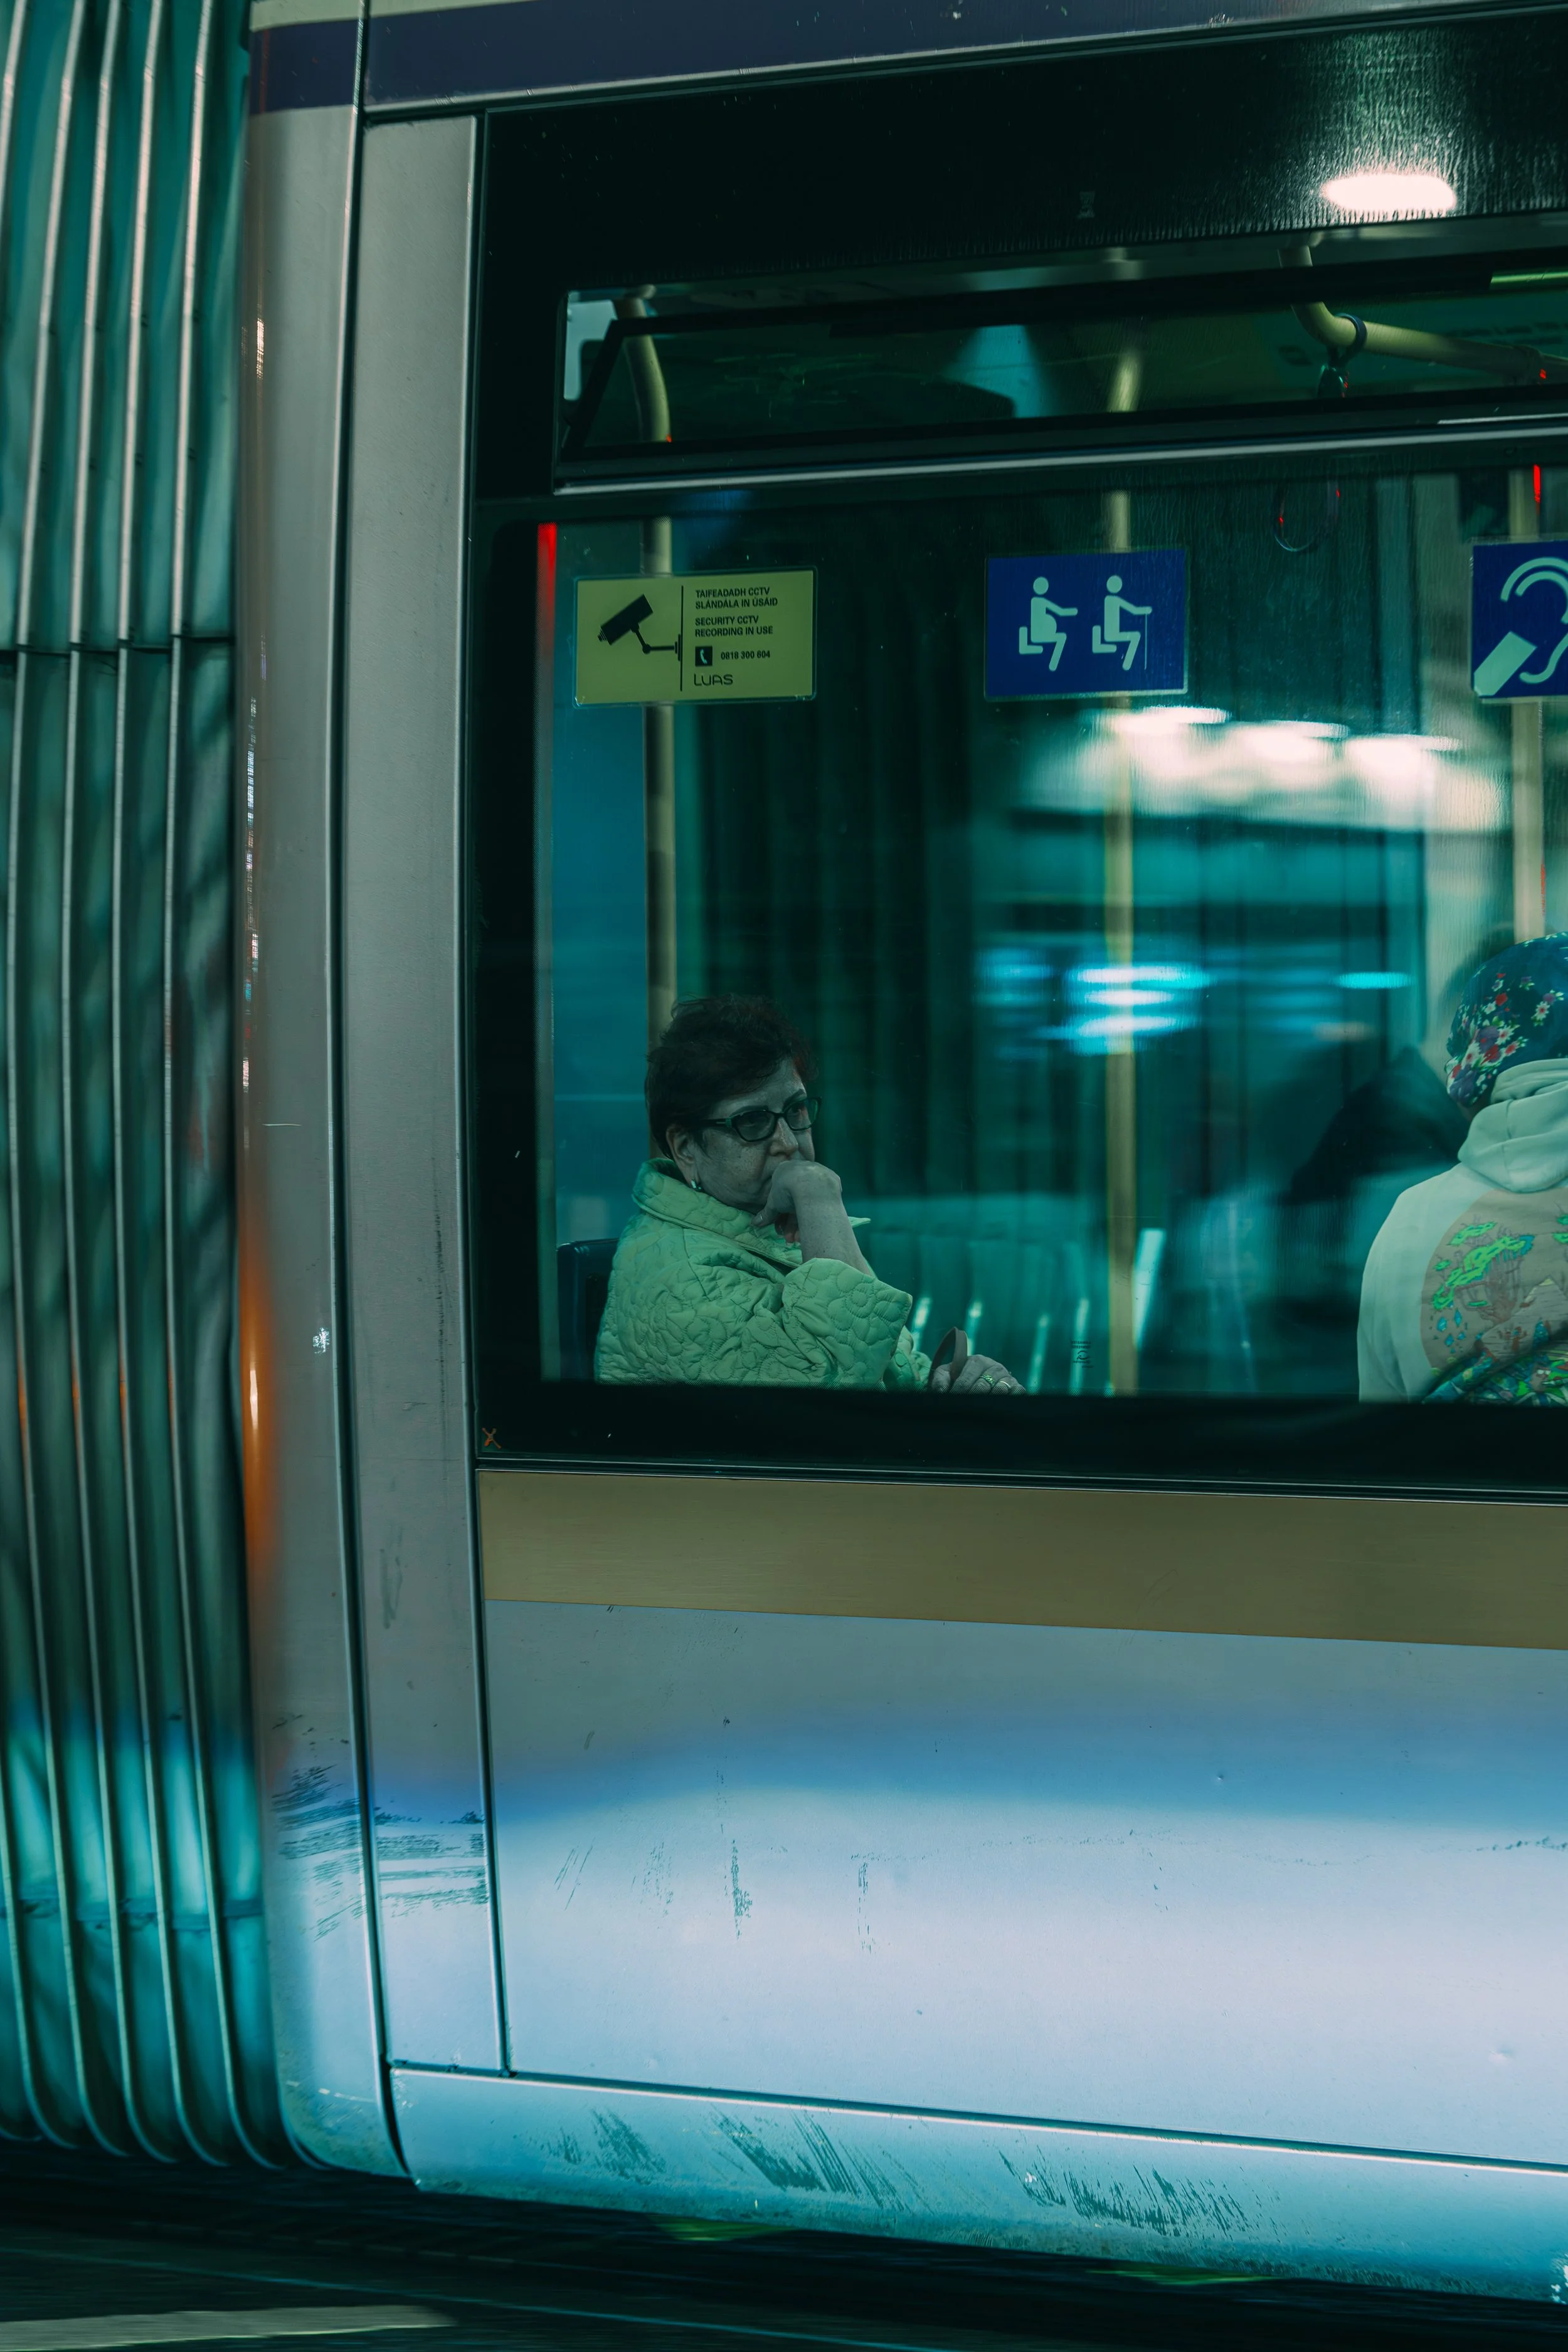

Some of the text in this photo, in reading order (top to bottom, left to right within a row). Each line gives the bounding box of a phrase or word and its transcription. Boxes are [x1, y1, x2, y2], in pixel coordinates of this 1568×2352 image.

[695, 586, 770, 598] TAIFEADADH CCTV
[695, 598, 739, 610] SLÁNDÁLA
[741, 598, 750, 607] IN
[695, 615, 759, 626] SECURITY CCTV
[695, 625, 773, 637] RECORDING IN USE
[721, 651, 739, 660] 0818
[741, 650, 755, 659] 300
[694, 673, 733, 686] LUAS
